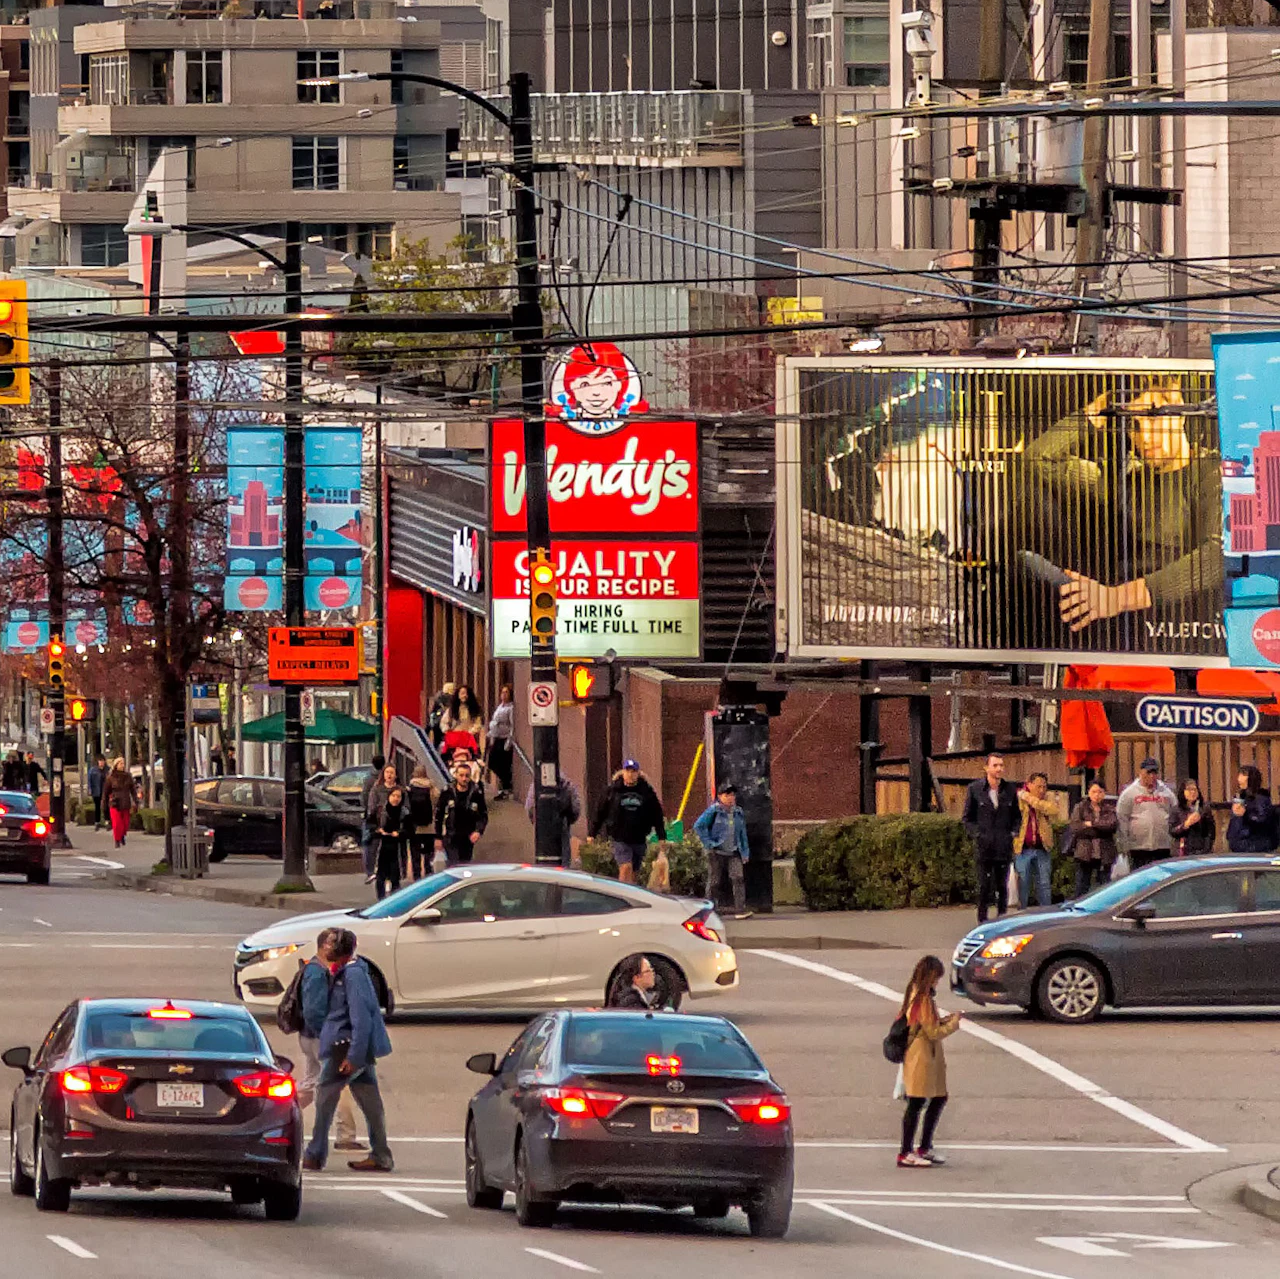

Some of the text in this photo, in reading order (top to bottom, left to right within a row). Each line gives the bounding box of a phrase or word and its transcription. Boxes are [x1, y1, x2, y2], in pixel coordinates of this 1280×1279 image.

[574, 605, 623, 618] HIRING
[564, 621, 598, 633] TIME
[603, 621, 639, 633] FULL
[648, 621, 682, 633] TIME
[1146, 704, 1249, 728] PATTISON
